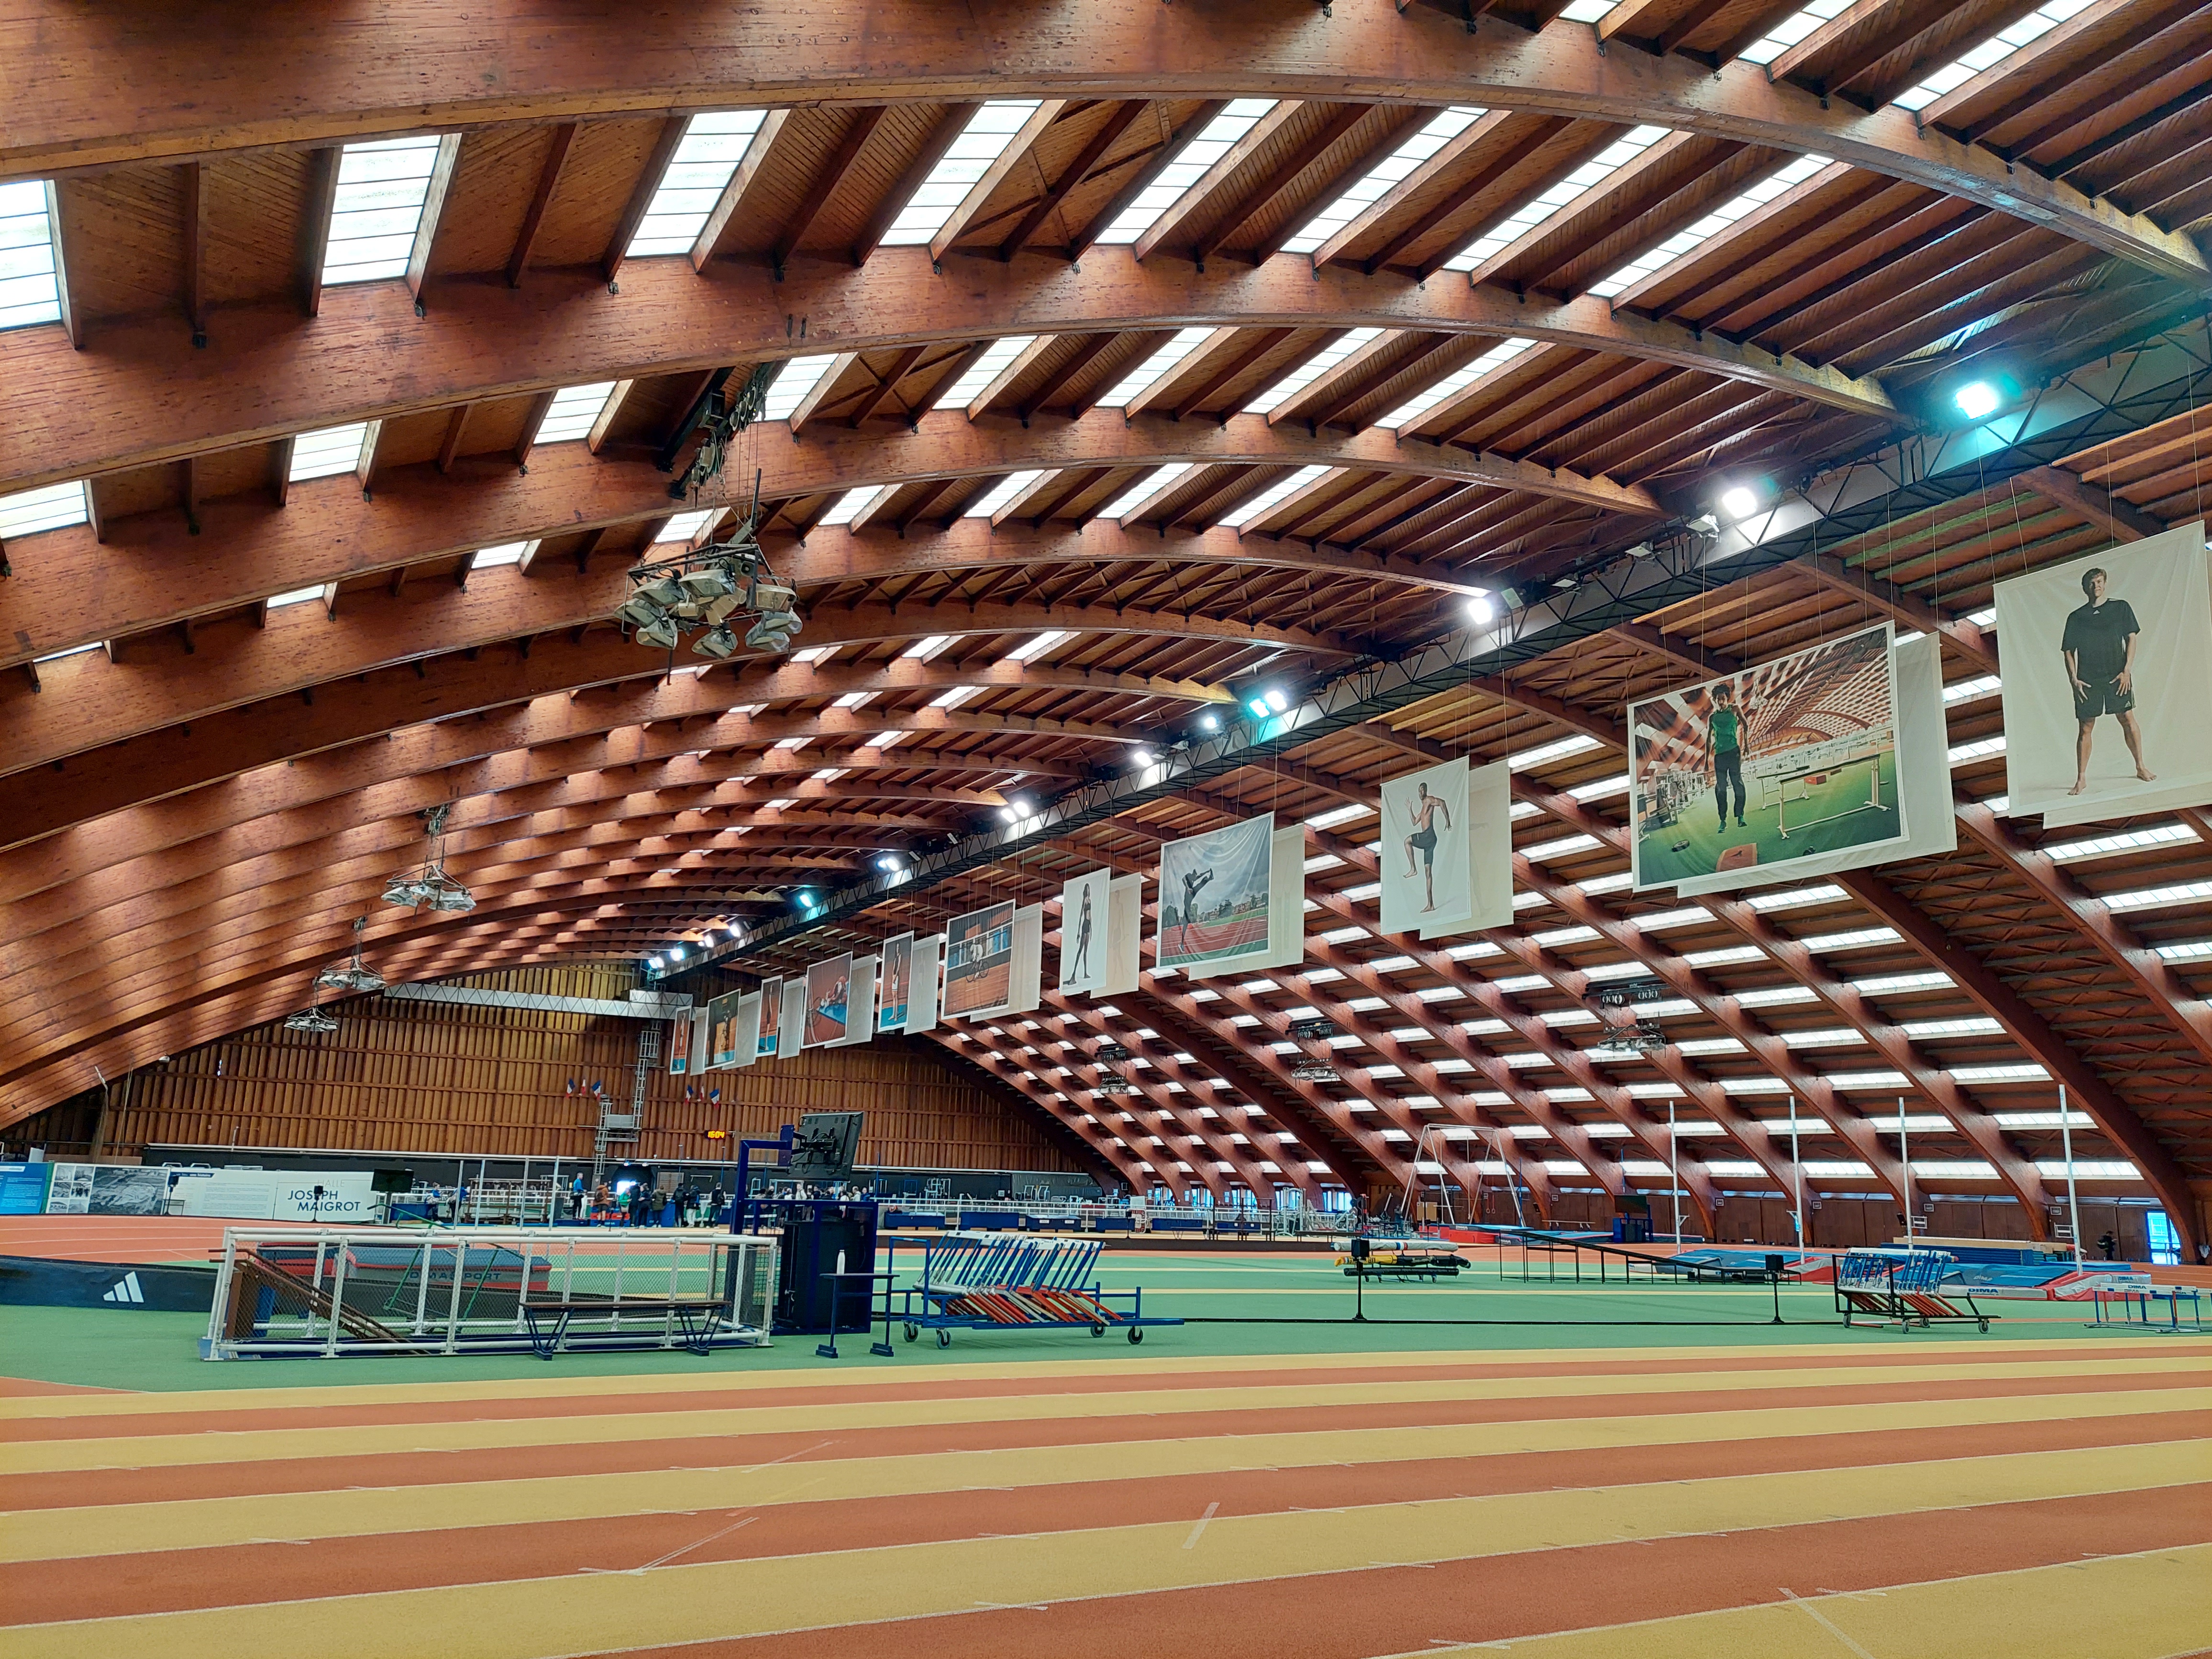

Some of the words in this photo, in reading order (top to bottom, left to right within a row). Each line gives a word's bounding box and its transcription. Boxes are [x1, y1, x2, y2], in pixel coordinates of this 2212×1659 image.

[317, 1179, 345, 1188] HALLE
[288, 1190, 339, 1200] JOSPH
[297, 1201, 361, 1212] MAIGROT
[410, 1271, 501, 1281] DMASPORT
